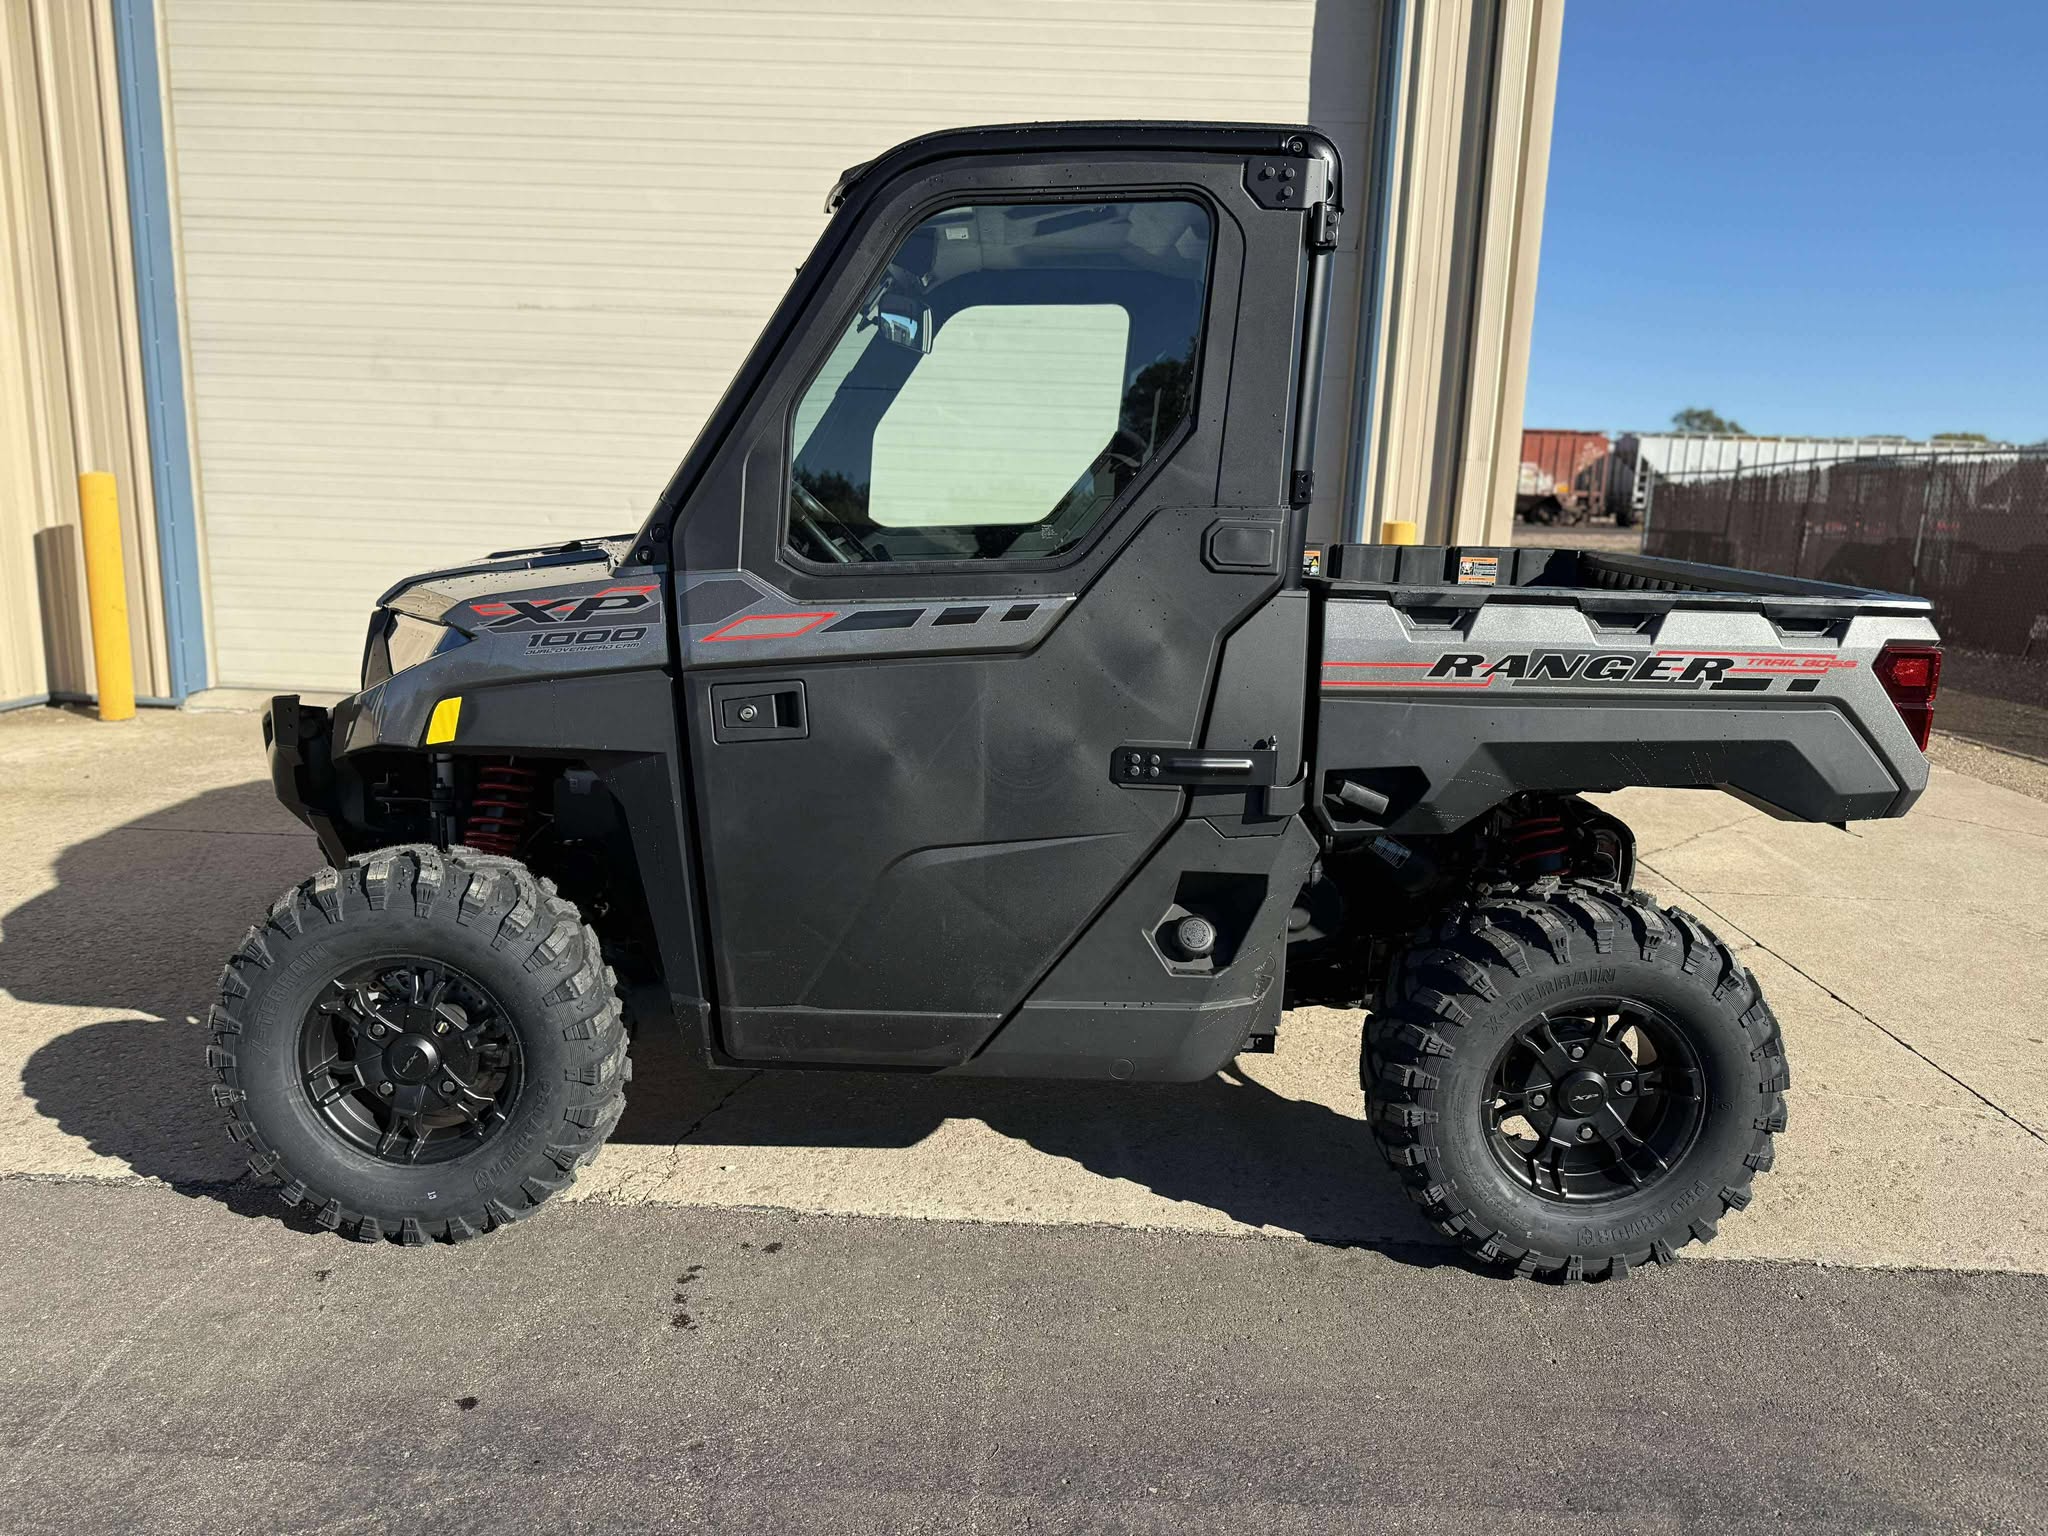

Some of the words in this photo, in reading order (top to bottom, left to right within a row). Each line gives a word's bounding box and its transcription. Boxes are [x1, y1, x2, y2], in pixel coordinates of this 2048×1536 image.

[482, 594, 655, 628] XP
[527, 626, 649, 648] 1000
[1426, 653, 1736, 683] RANGER
[1747, 658, 1800, 668] TRAIL
